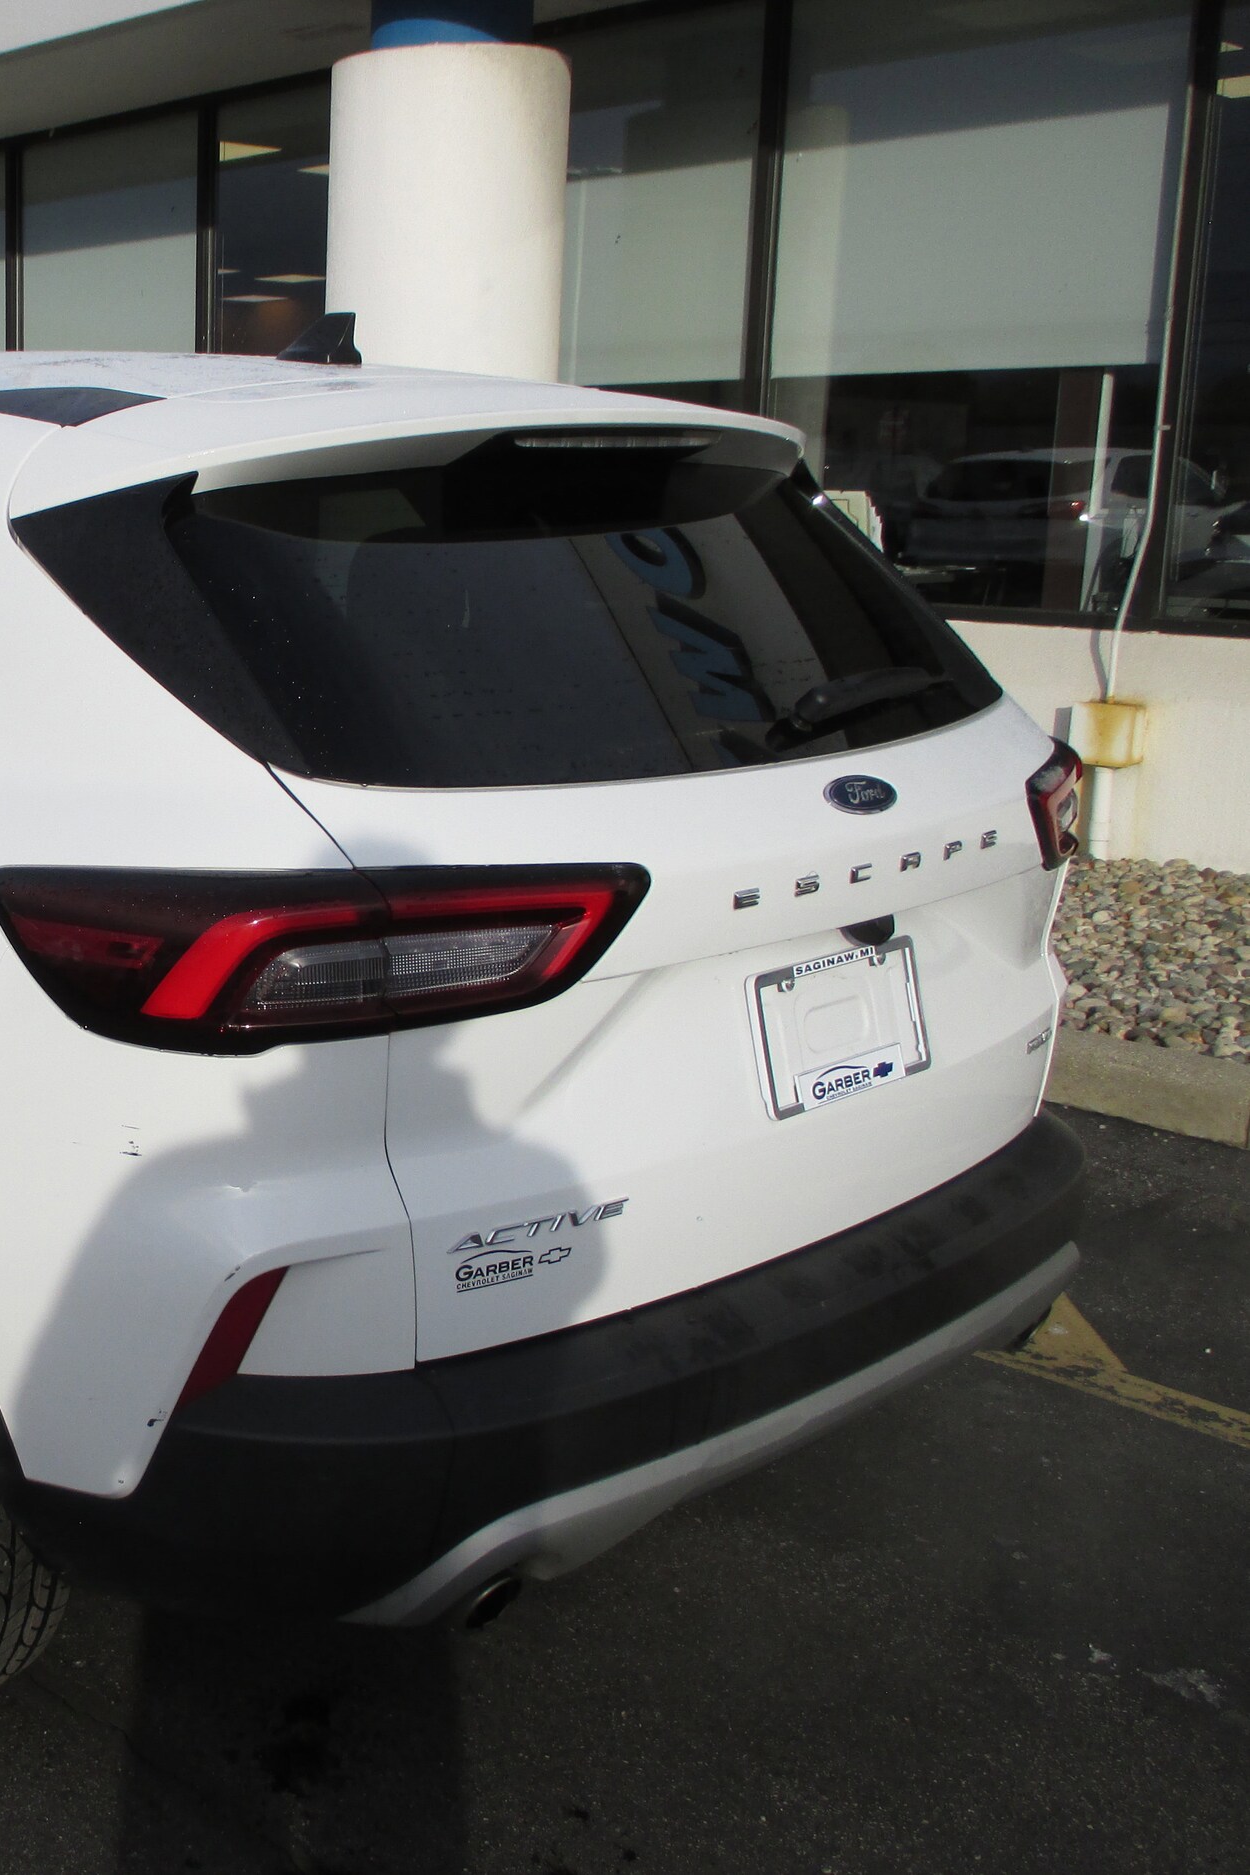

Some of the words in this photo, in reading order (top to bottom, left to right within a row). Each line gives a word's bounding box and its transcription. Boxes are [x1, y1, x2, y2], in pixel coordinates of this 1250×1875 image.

[844, 780, 885, 804] Ford
[733, 828, 999, 911] ESCAPE
[812, 1068, 872, 1101] GARBER
[446, 1196, 630, 1254] ACTIVE
[455, 1255, 534, 1282] GARBER
[456, 1275, 500, 1290] CHEVROLET
[501, 1267, 534, 1281] SAGINAW
